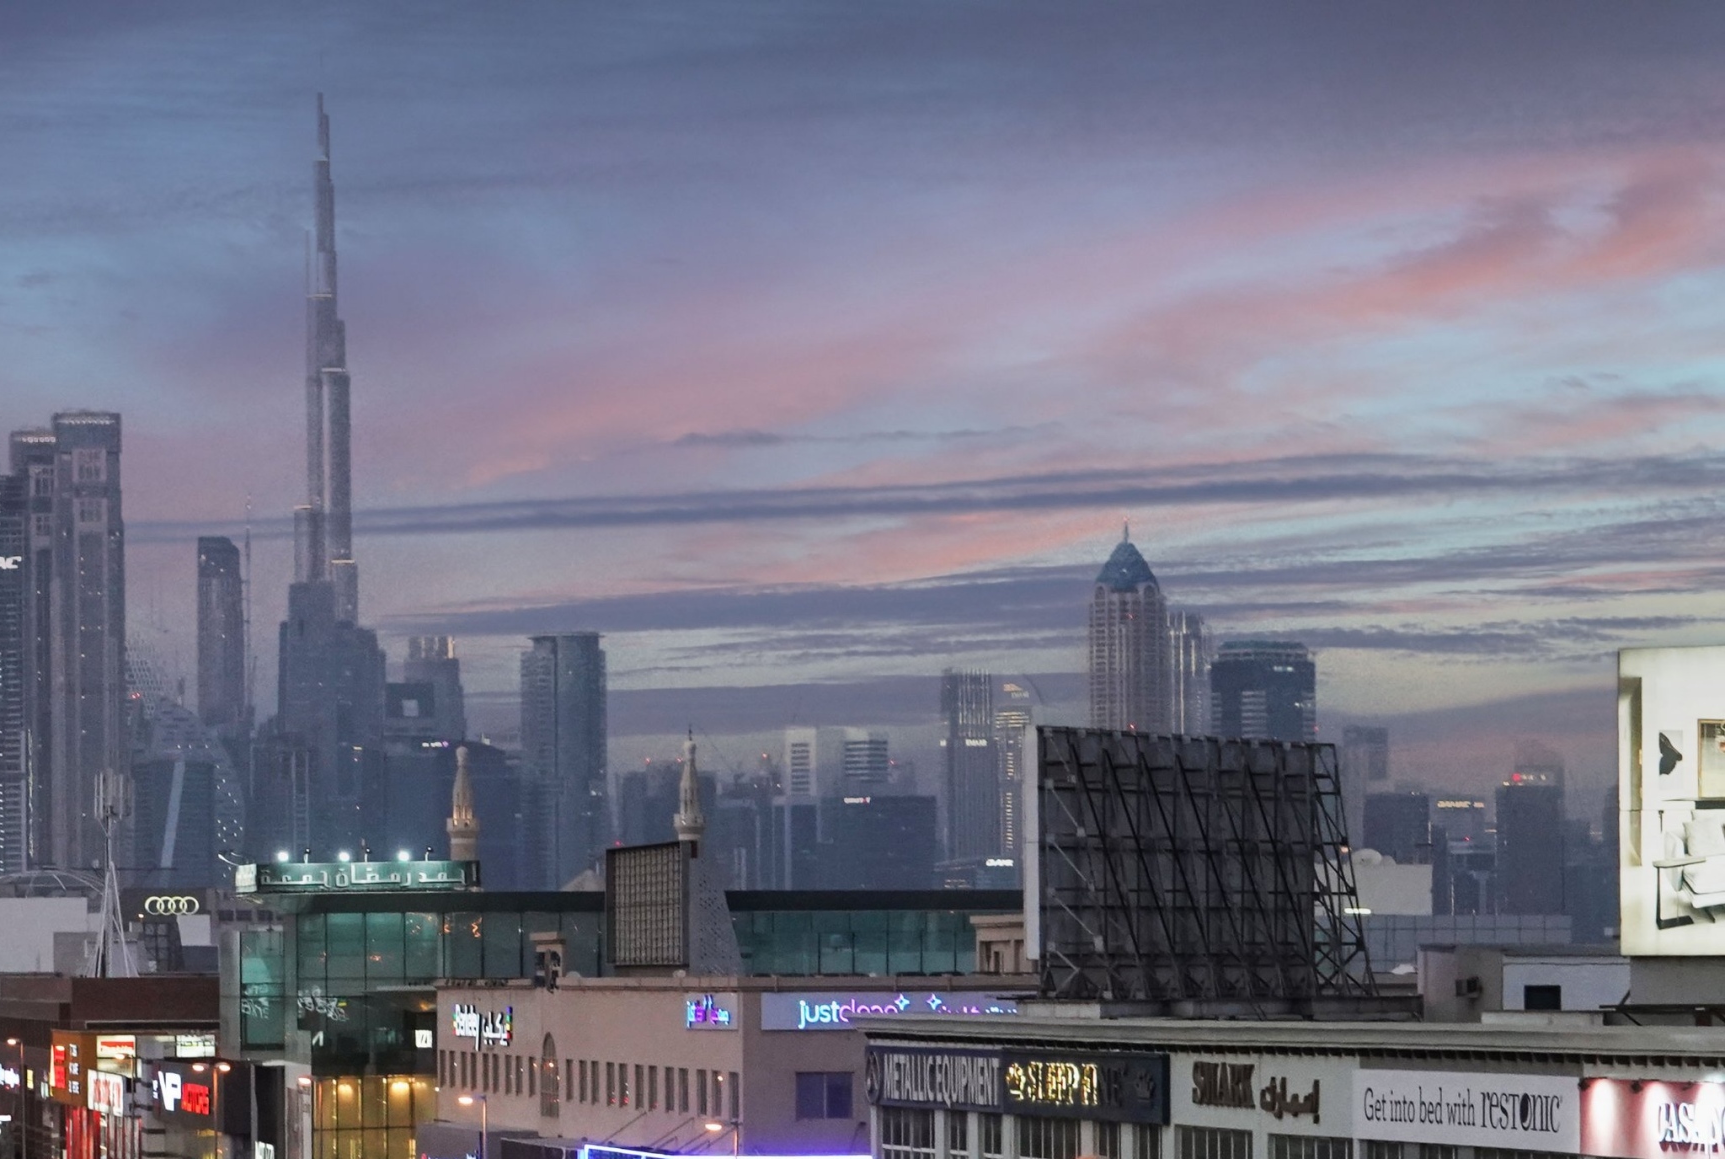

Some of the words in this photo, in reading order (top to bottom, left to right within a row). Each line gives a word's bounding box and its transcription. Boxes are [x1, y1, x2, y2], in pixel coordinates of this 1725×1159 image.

[883, 1053, 935, 1102] METALLIC
[936, 1055, 1001, 1109] EQUIPMENT
[1363, 1087, 1387, 1123] Get
[1389, 1090, 1415, 1125] into
[1418, 1087, 1443, 1126] bed
[1445, 1090, 1475, 1128] with
